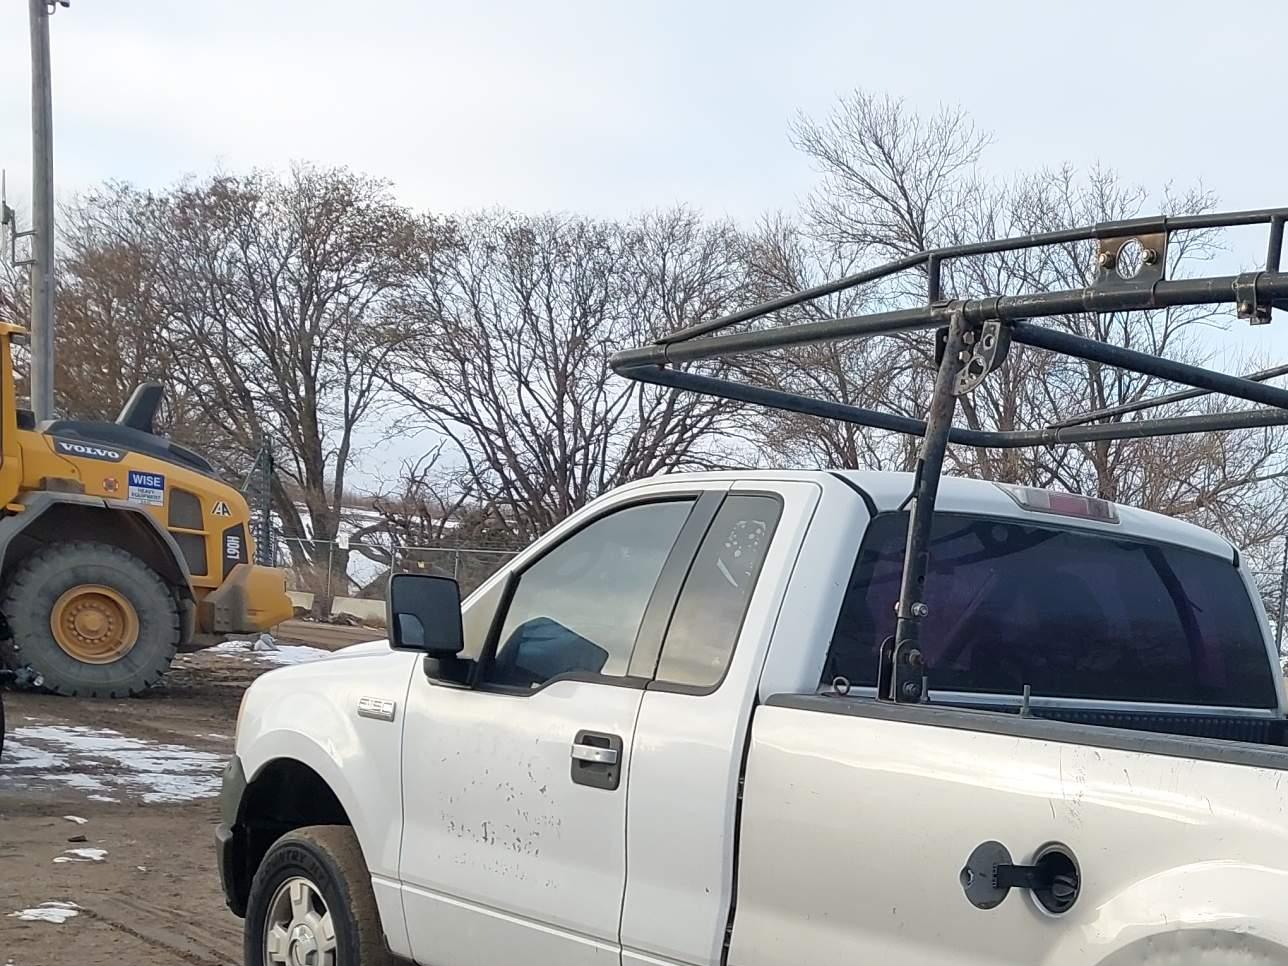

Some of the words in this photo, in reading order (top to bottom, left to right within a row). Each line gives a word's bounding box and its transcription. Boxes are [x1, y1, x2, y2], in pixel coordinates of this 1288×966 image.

[60, 442, 120, 459] VOLVO
[132, 473, 161, 487] WISE
[226, 535, 240, 560] L90H
